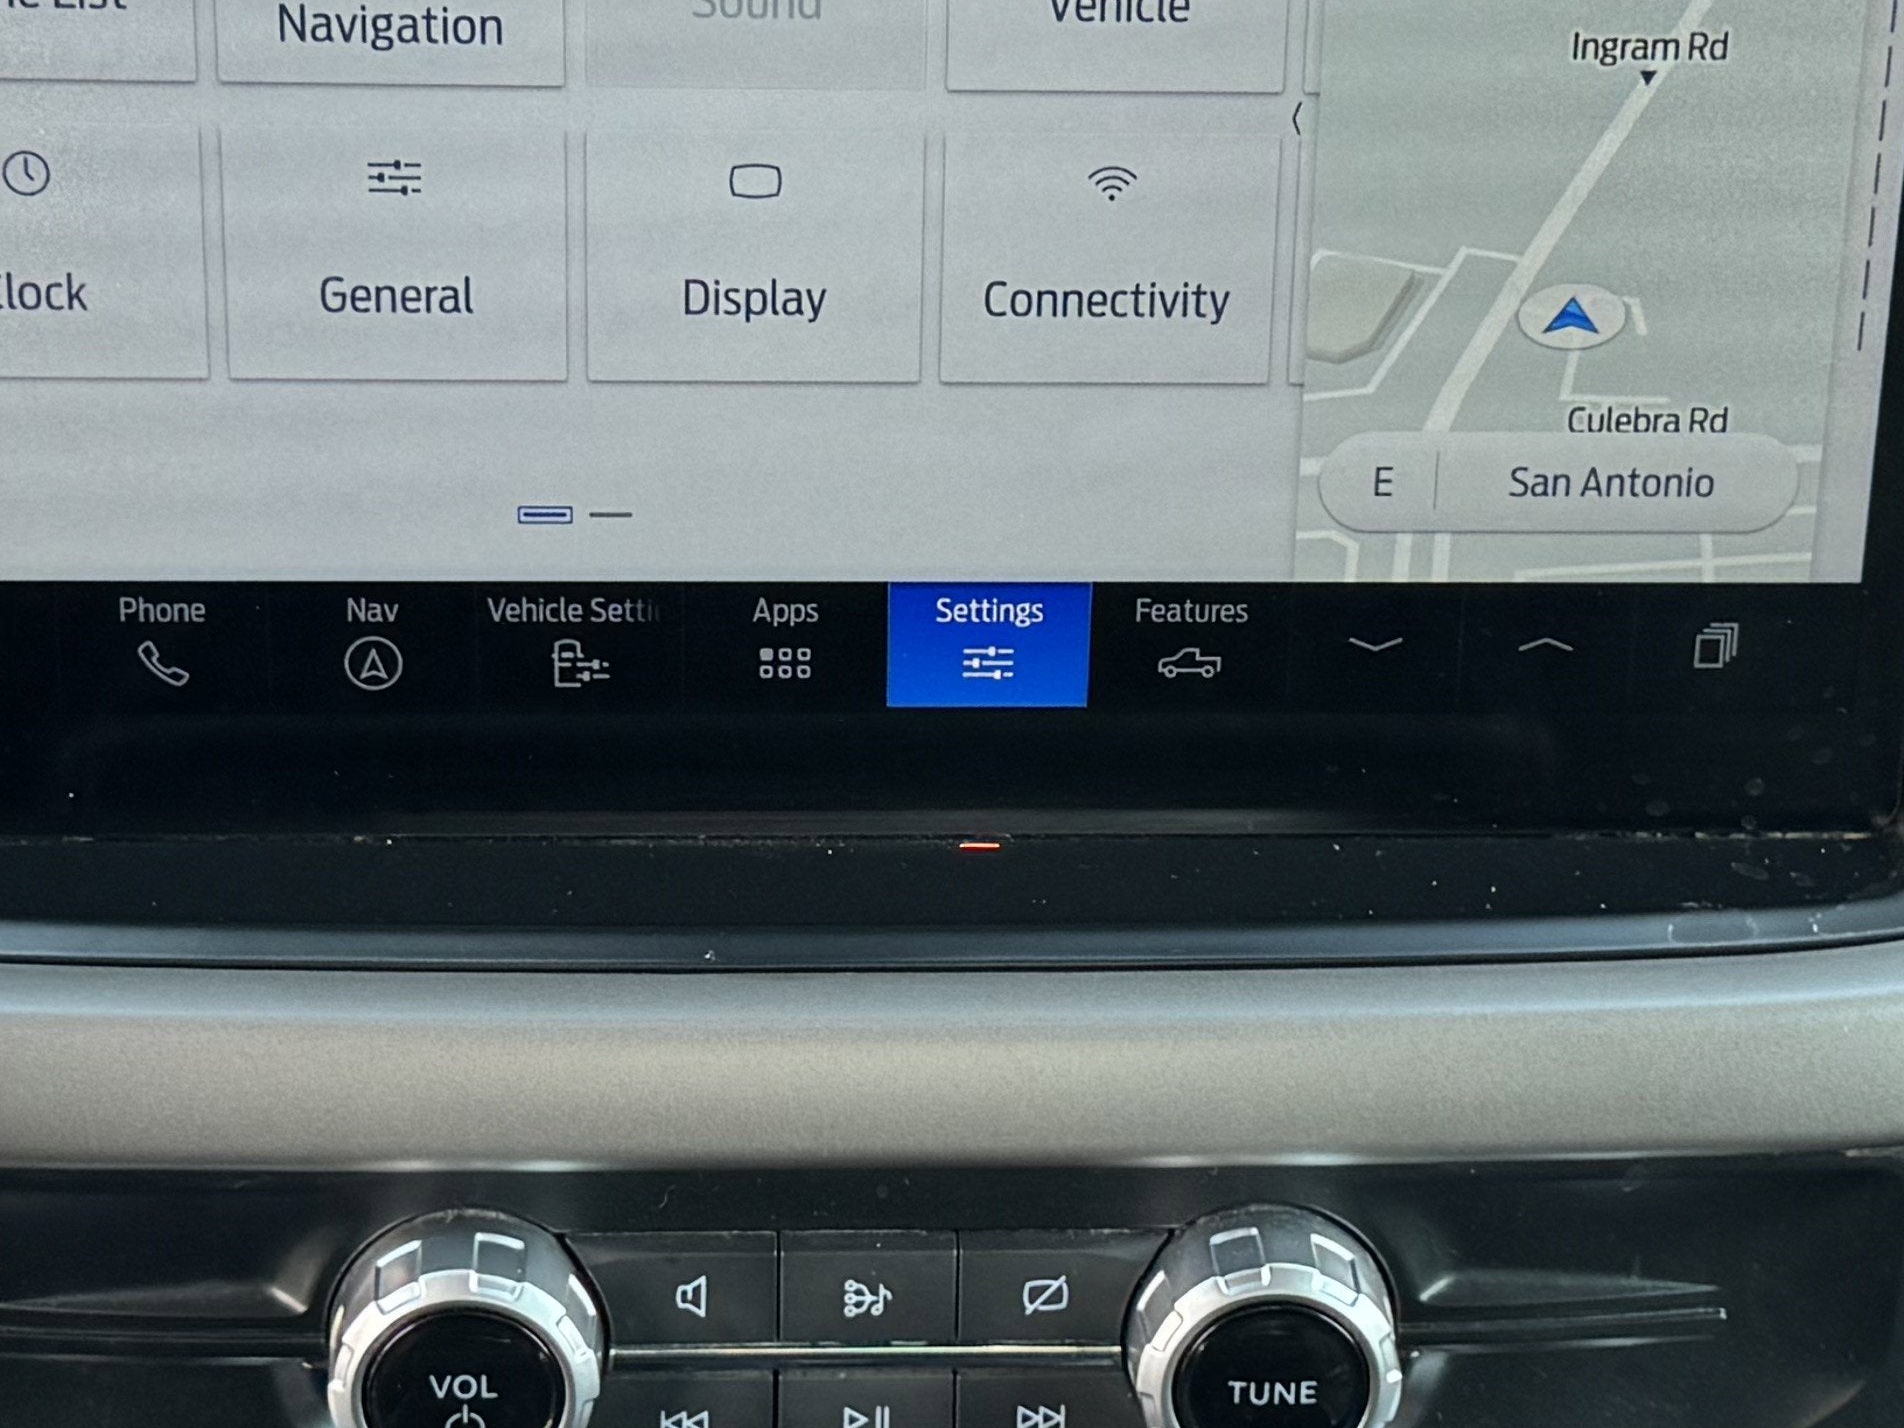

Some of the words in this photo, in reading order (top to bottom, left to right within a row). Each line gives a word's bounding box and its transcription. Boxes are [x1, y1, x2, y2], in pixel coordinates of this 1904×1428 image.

[278, 3, 503, 52] Navigation
[1573, 31, 1680, 67] Ingram
[1686, 29, 1729, 65] Rd
[320, 275, 474, 314] General
[684, 278, 827, 324] Display
[984, 280, 1231, 326] Connectivity
[1566, 403, 1681, 436] Culebra
[1687, 403, 1729, 434] Rd
[1373, 466, 1394, 497] E
[1508, 466, 1571, 498] San
[1579, 466, 1715, 498] Antonio
[119, 596, 206, 623] Phone
[347, 597, 399, 623] Nav
[486, 596, 583, 623] Vehicle
[752, 597, 819, 627] Apps
[935, 597, 1044, 628] Settings
[1135, 597, 1249, 623] Features
[429, 1374, 498, 1400] VOL
[1228, 1380, 1318, 1406] TUNE
